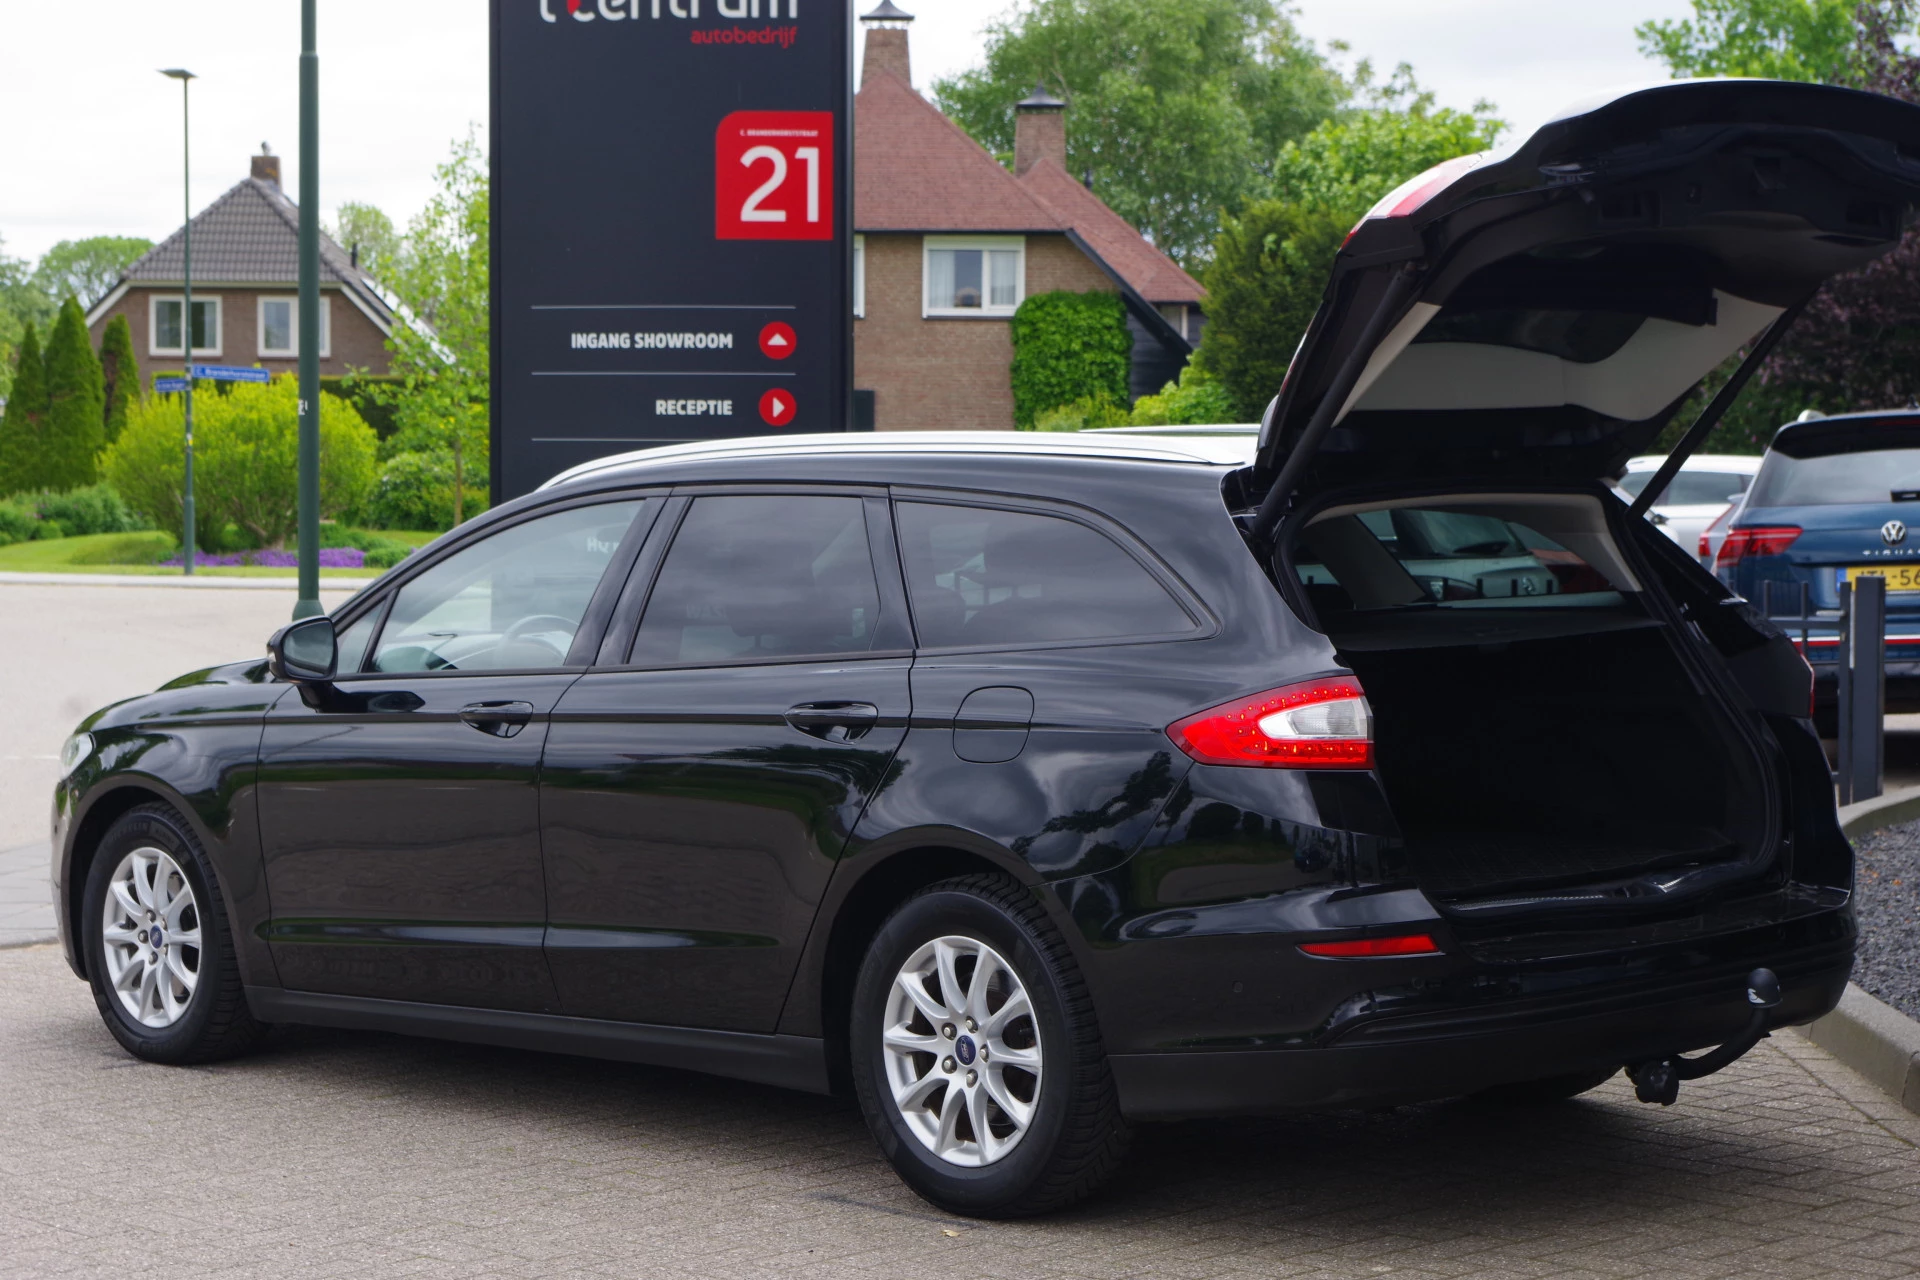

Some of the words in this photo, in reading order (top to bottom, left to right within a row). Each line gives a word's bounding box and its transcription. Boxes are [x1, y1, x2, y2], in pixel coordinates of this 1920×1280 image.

[690, 26, 797, 48] autobedrijf
[740, 145, 819, 222] 21
[571, 332, 631, 349] INGANG
[634, 332, 733, 349] SHOWROOM
[656, 399, 733, 416] RECEPTIE
